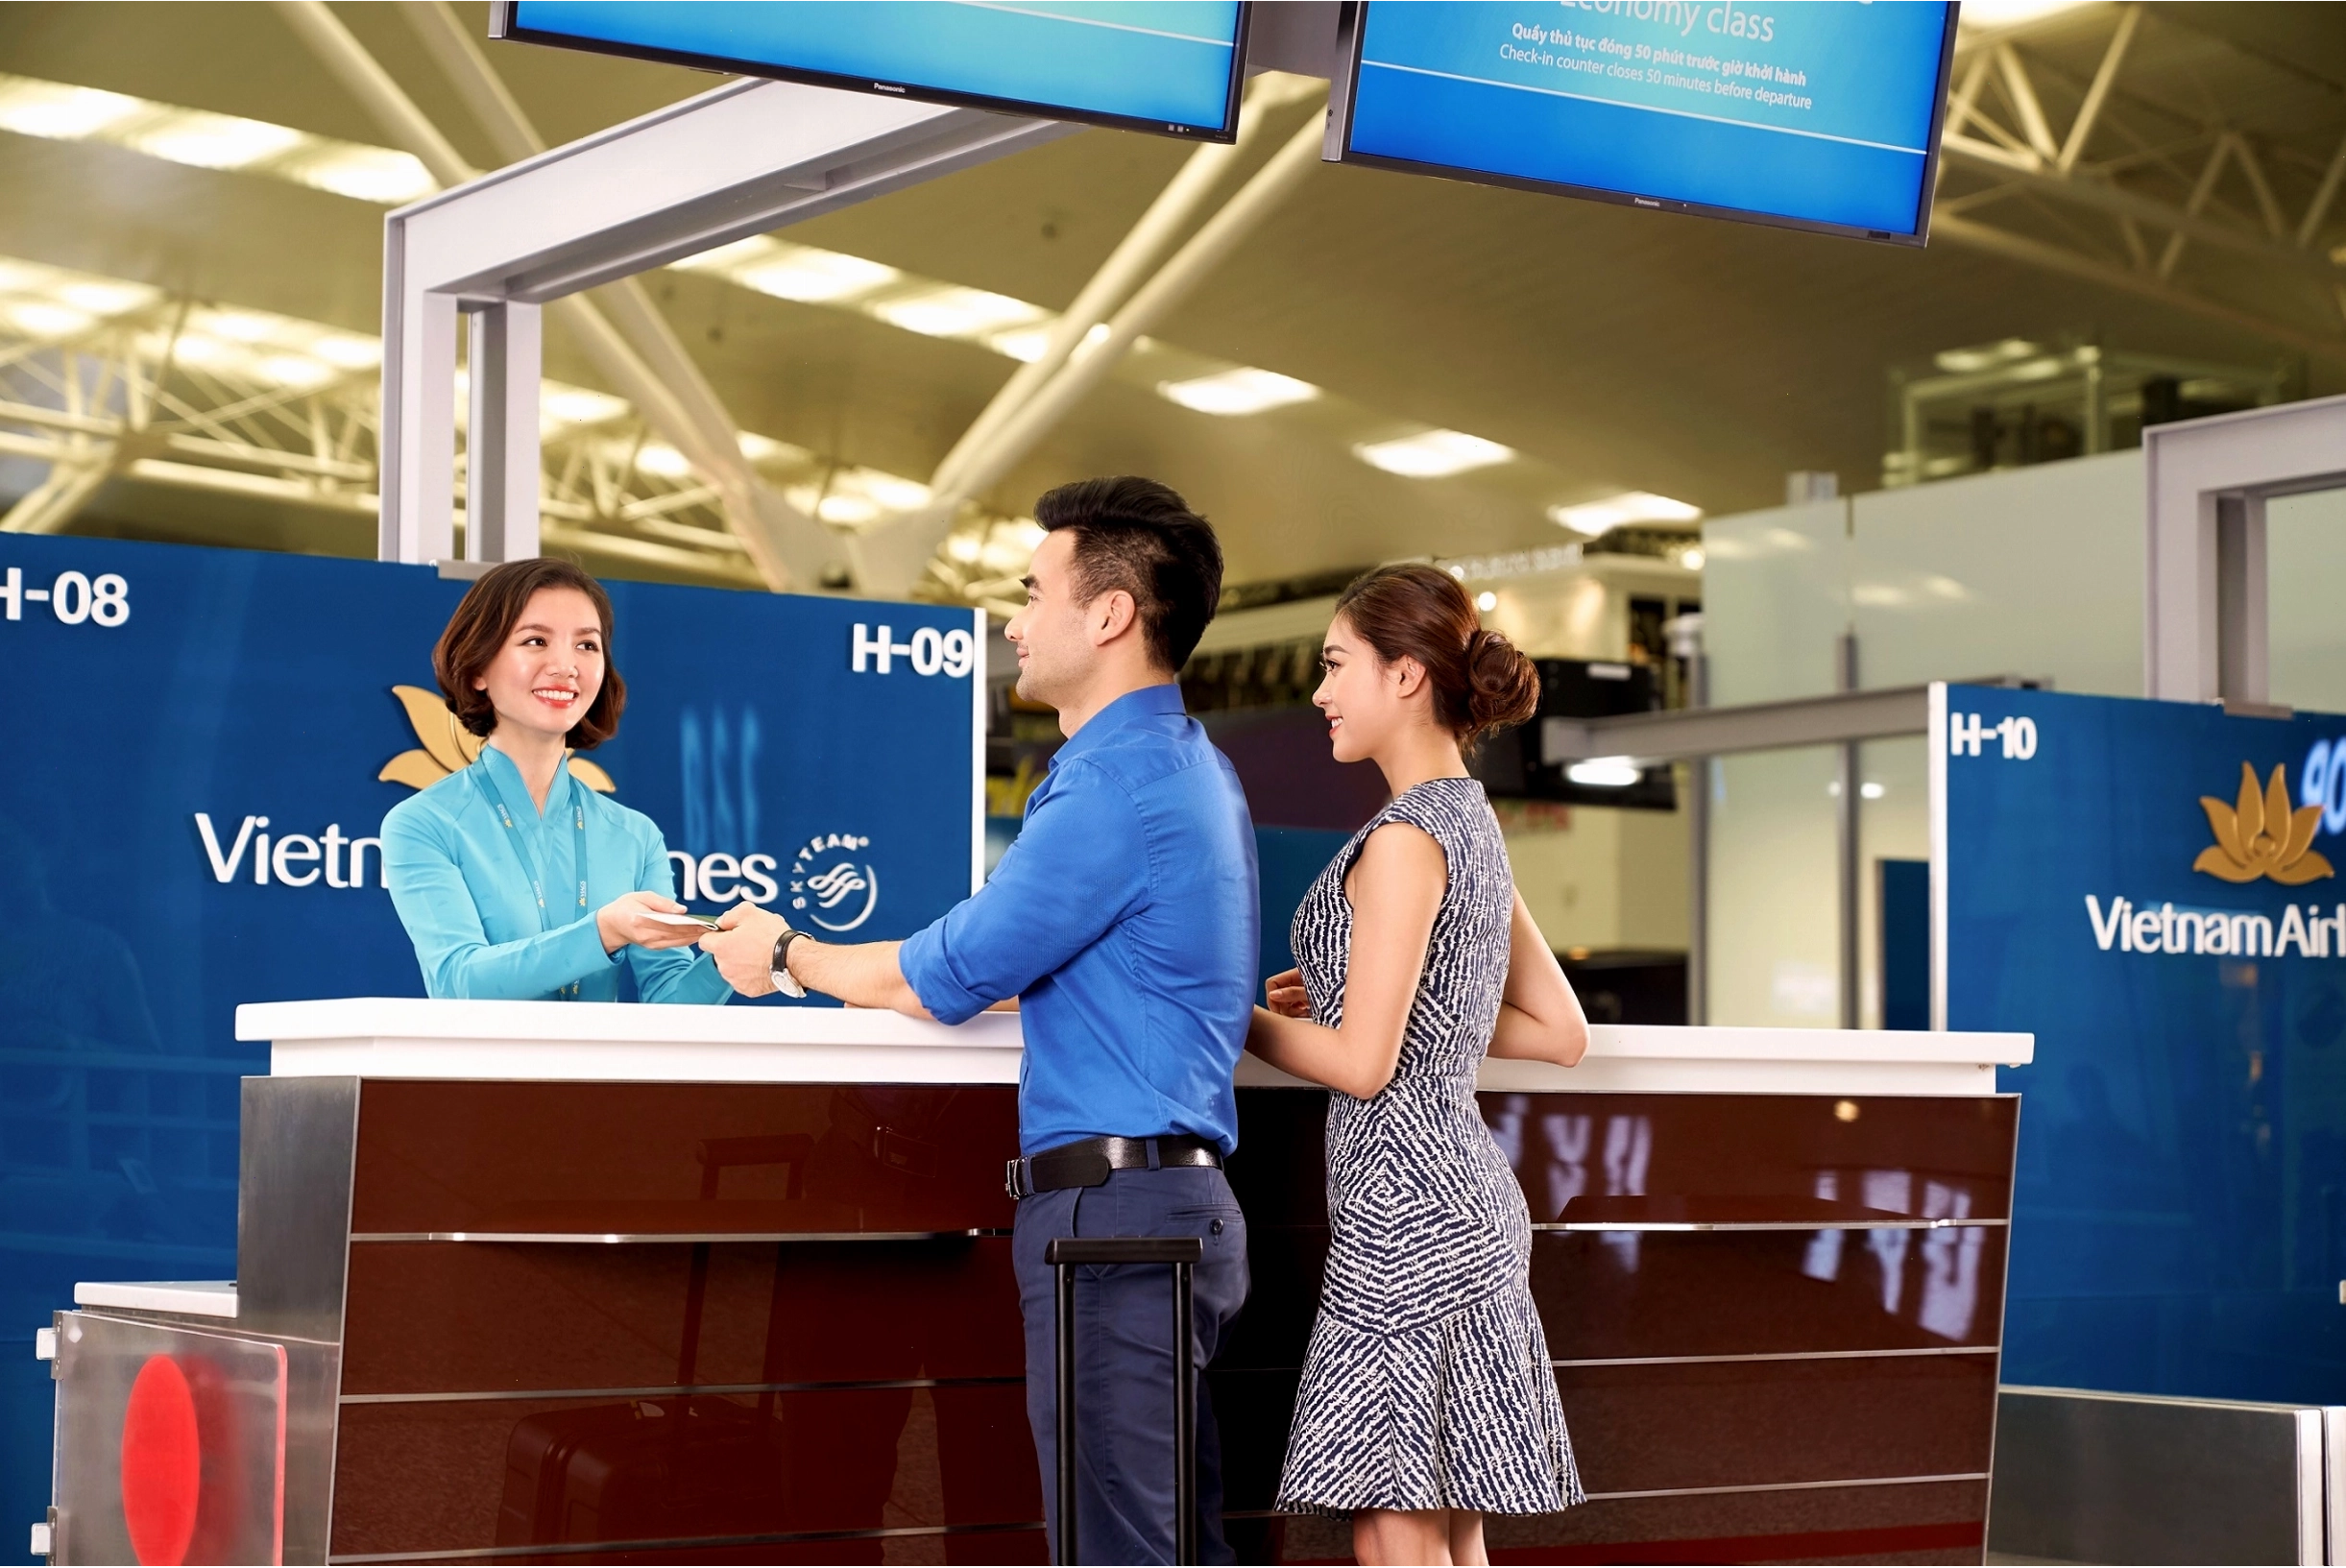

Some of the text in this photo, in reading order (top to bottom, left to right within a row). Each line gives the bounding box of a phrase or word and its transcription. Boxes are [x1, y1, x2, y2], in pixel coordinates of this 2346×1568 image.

[1707, 0, 1775, 41] class
[1499, 43, 1812, 109] Check-in counter closes 50 minutes before departure
[1512, 22, 1807, 86] Quầy thủ tục đóng 50 phút trước giờ khởi hành
[874, 83, 906, 93] Panasonic
[852, 622, 974, 678] H-09
[1950, 712, 2037, 760] H-10
[790, 833, 859, 910] SKYTEAM
[2085, 894, 2273, 956] Vietnam
